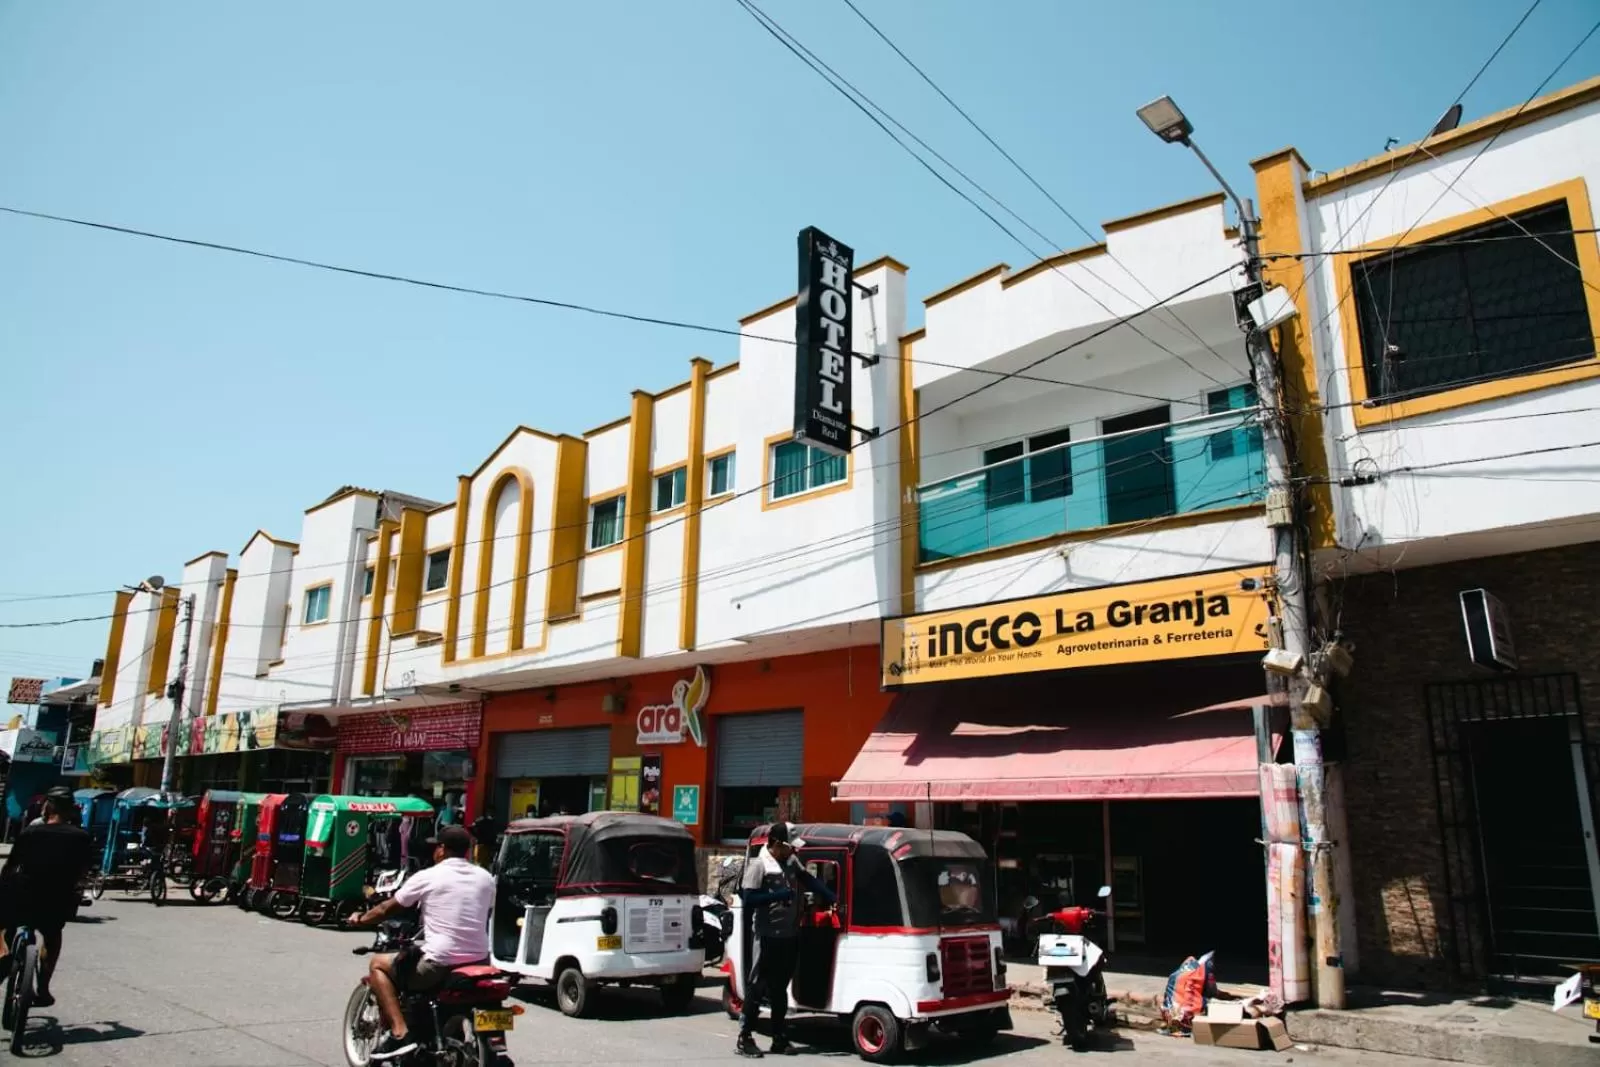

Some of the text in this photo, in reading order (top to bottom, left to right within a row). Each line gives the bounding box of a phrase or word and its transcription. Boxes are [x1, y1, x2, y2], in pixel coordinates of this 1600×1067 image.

[819, 256, 848, 415] HOTEL
[812, 409, 847, 431] Diamante
[822, 425, 838, 441] Real
[1055, 590, 1230, 636] La Granja
[1057, 627, 1233, 656] Agroveterinaria & Ferreteria
[965, 655, 987, 665] World
[998, 653, 1015, 662] Your
[1017, 650, 1043, 660] Hands
[639, 706, 681, 734] ara
[648, 898, 664, 906] TVS
